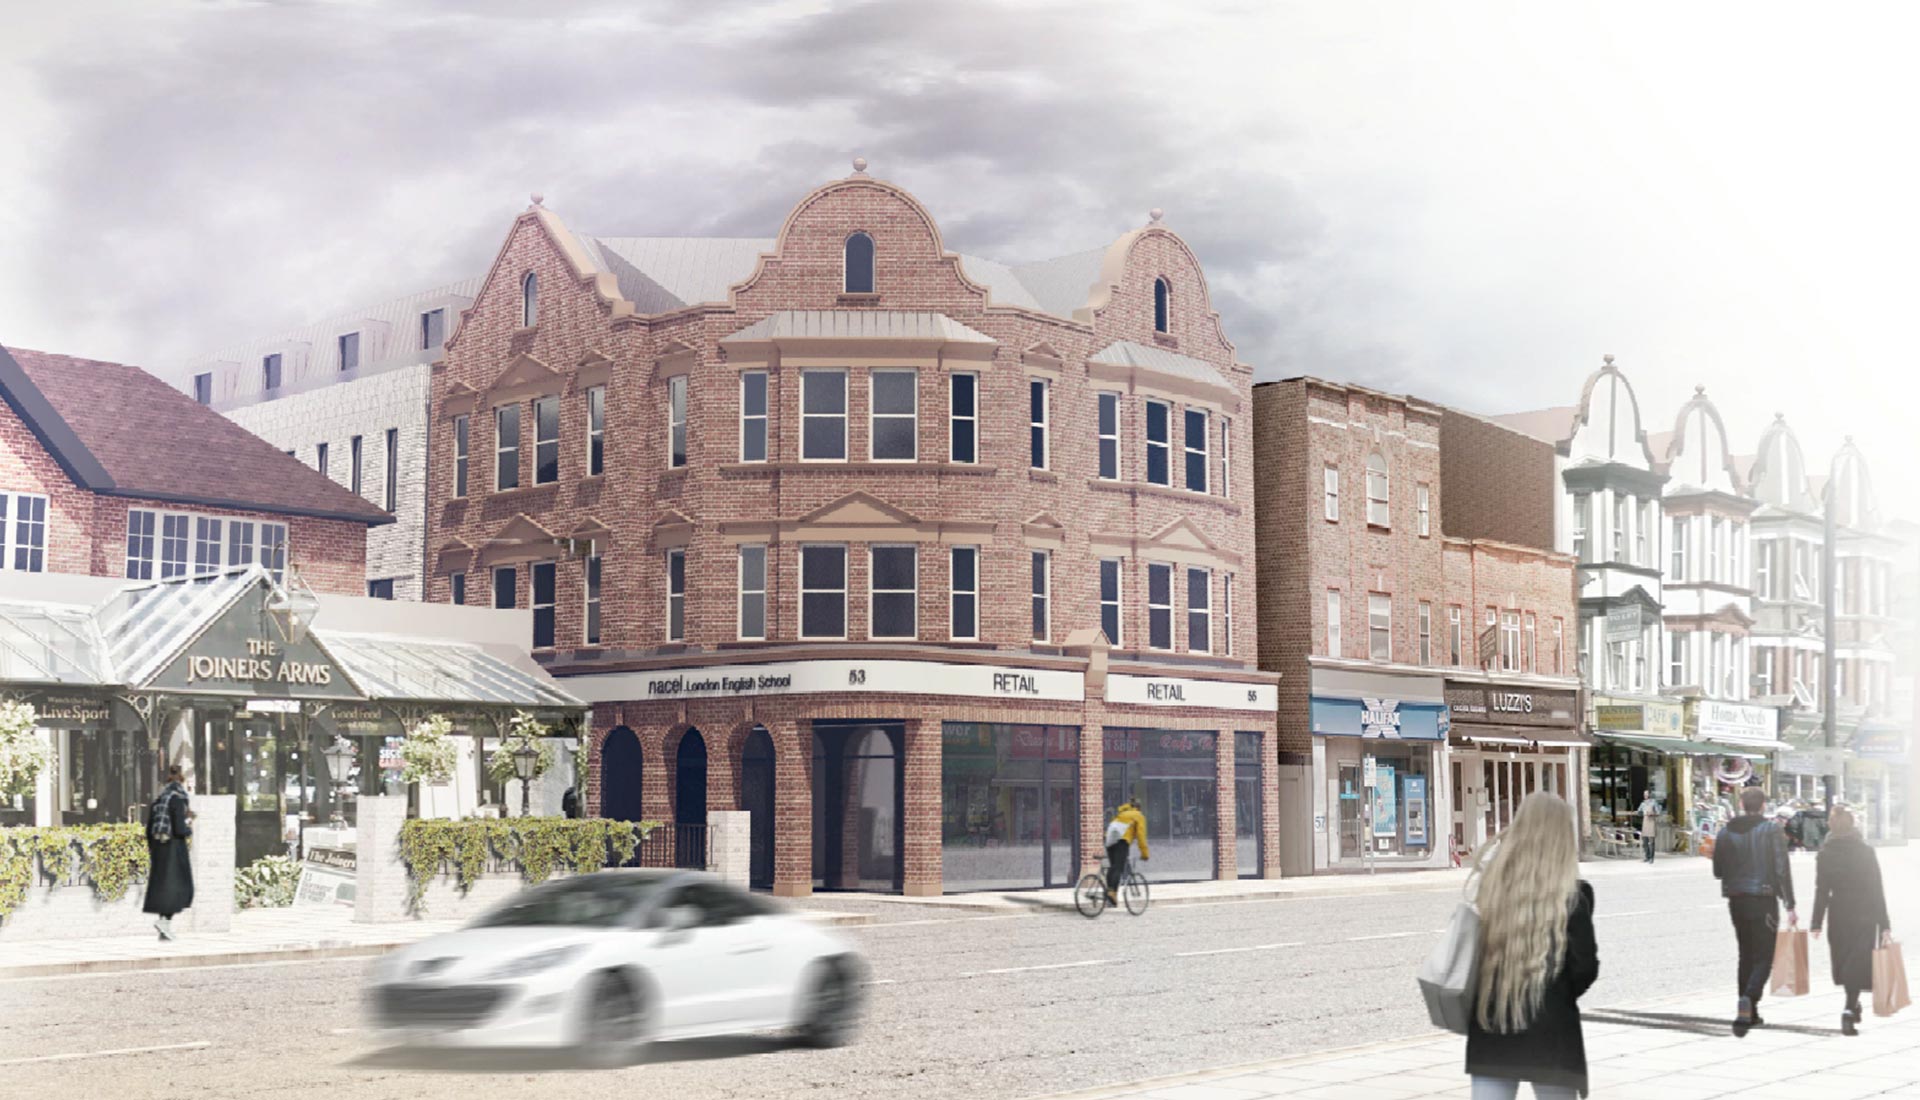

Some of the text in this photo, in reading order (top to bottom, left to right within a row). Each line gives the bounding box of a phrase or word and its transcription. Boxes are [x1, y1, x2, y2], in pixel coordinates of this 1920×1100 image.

[247, 637, 276, 656] THE
[187, 655, 331, 685] JOINERS ARMS
[848, 669, 866, 685] 53
[721, 676, 756, 693] English
[757, 673, 792, 688] School
[992, 672, 1040, 694] RETAIL
[1146, 682, 1187, 702] RETAIL
[1492, 693, 1533, 713] LUZZI'S
[41, 704, 110, 724] Live Sport
[1361, 711, 1401, 726] HALIFAX
[1711, 705, 1767, 727] Home Needs
[1314, 815, 1326, 829] 57
[309, 850, 325, 862] The
